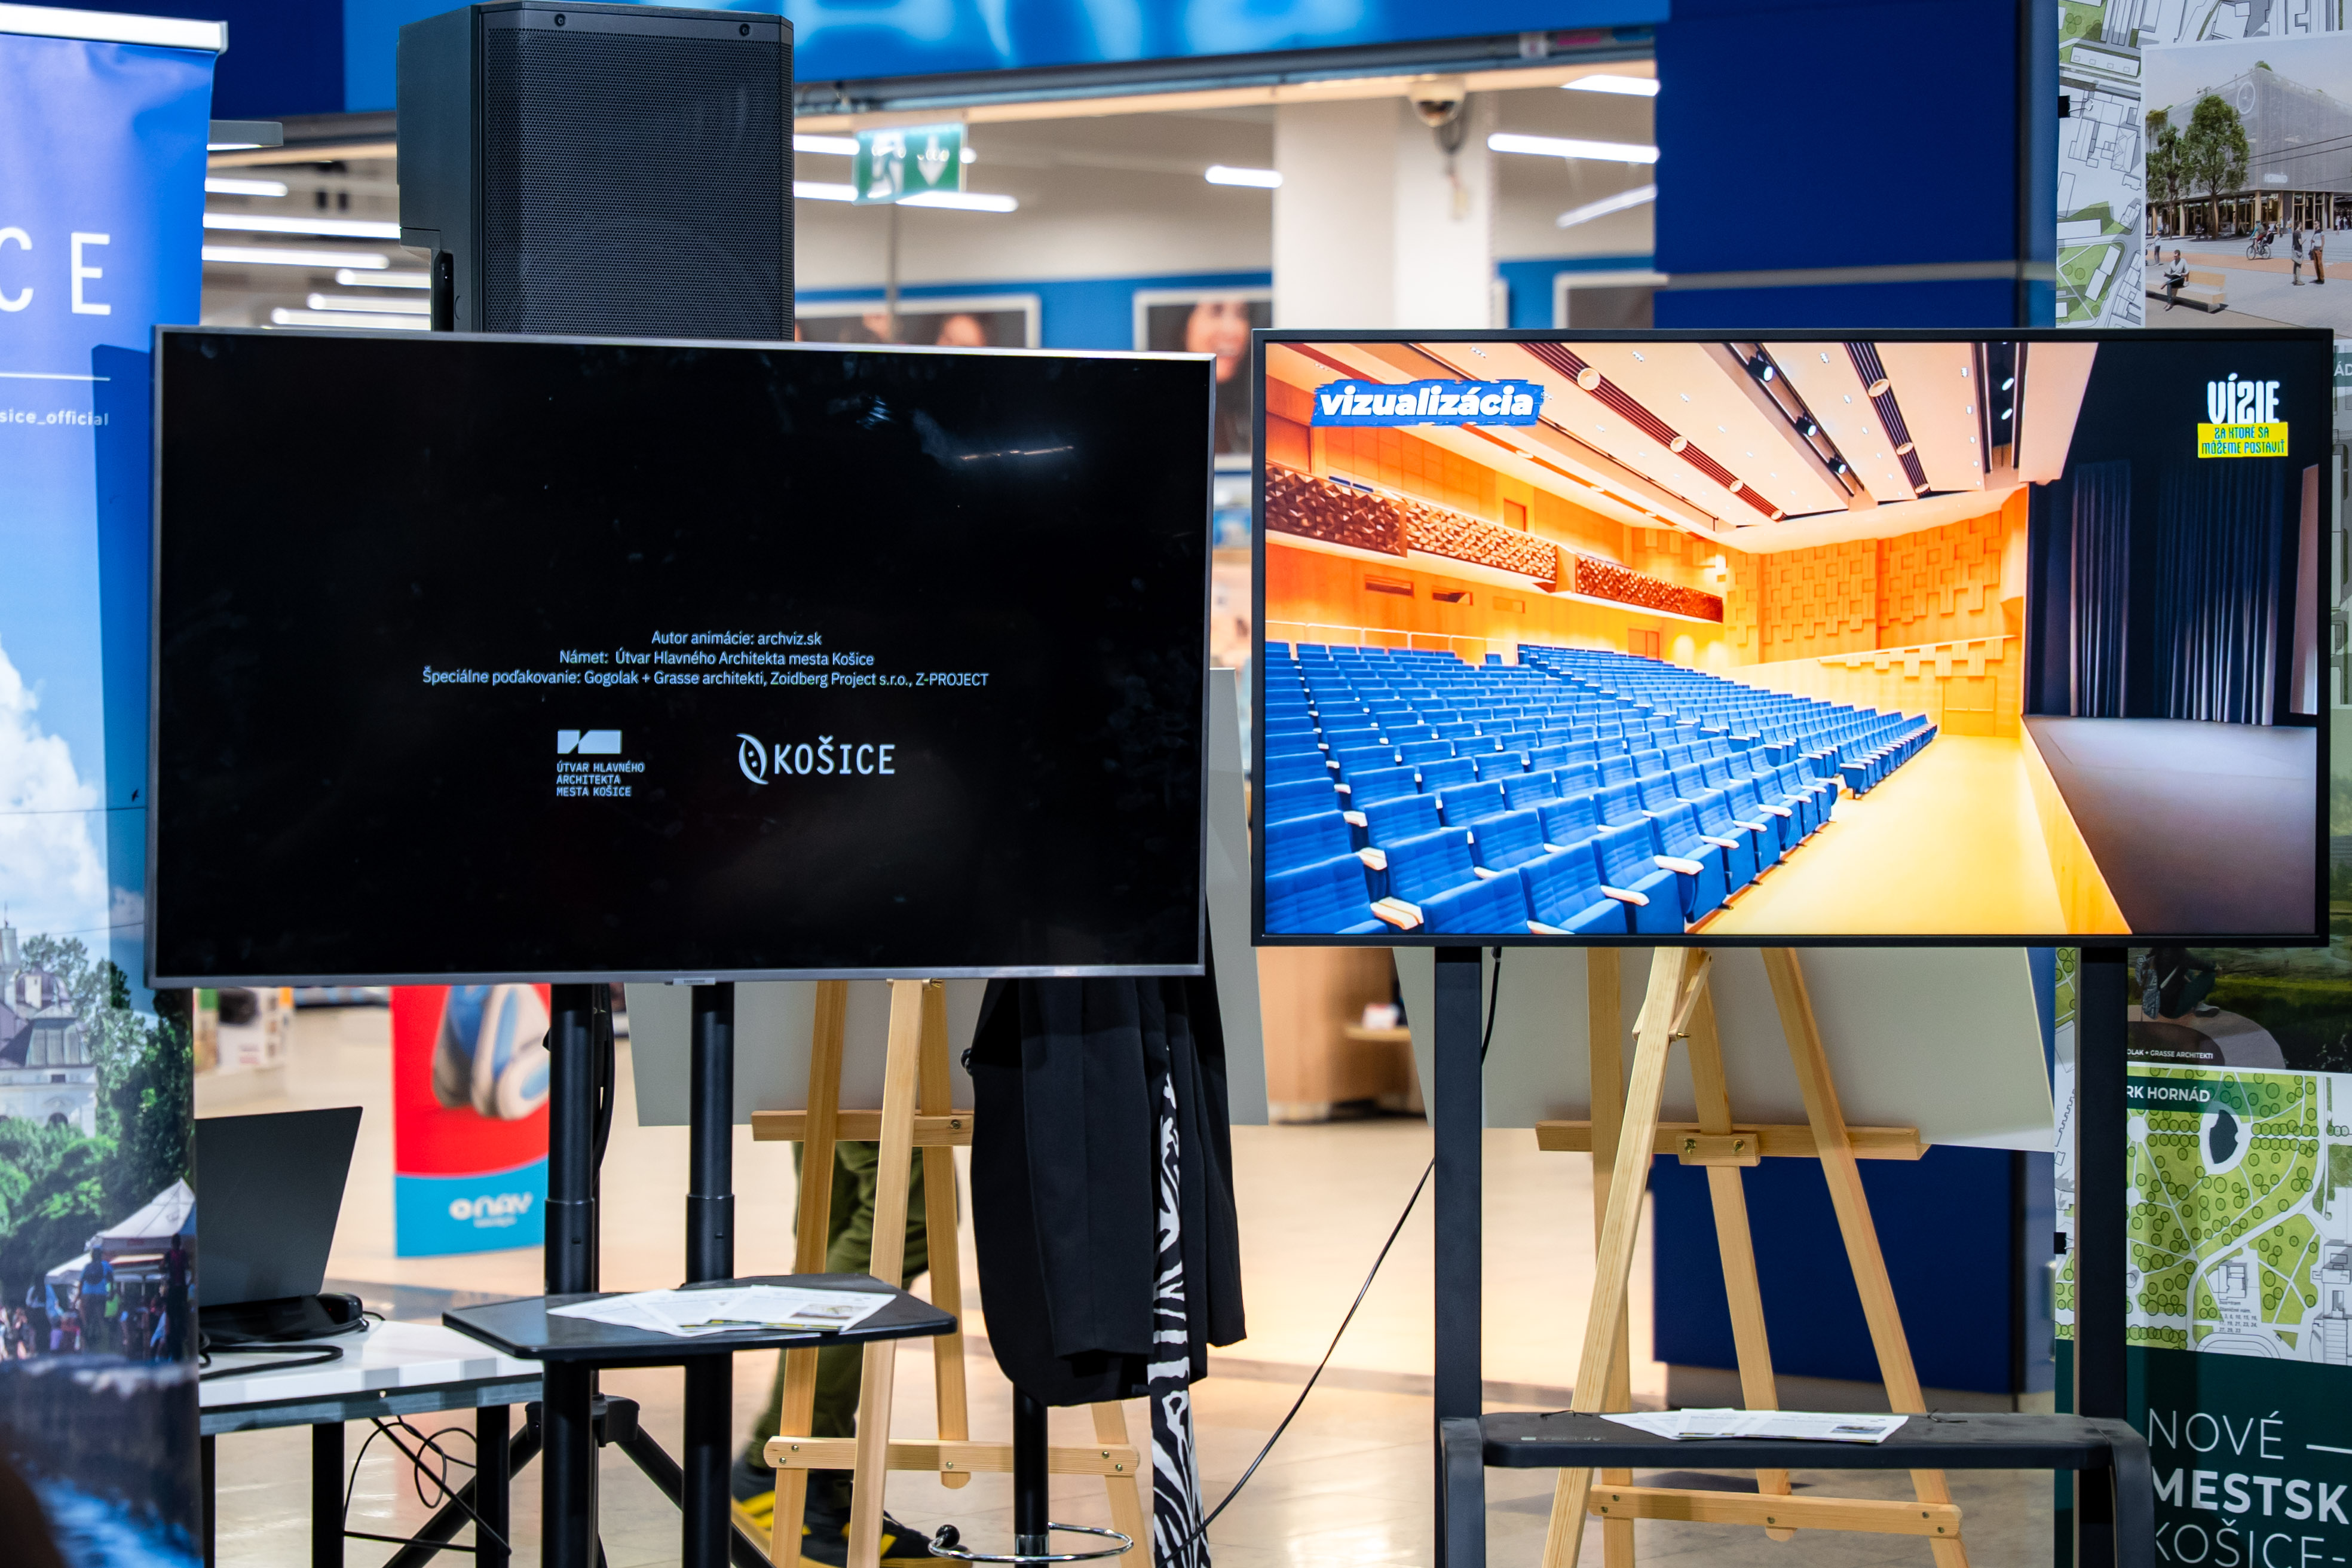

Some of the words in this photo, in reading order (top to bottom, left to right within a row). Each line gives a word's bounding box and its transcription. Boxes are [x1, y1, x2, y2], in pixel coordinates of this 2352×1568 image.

[1320, 385, 1534, 416] vizualizácia
[2215, 427, 2227, 439] ZA
[2229, 425, 2255, 439] KTORÉ
[2258, 426, 2270, 439] SA
[2201, 440, 2241, 455] MÔŽEME
[652, 631, 688, 645] Autor
[691, 631, 754, 645] animácie:
[758, 632, 822, 645] archviz.sk
[560, 649, 608, 664] Námet:
[615, 647, 651, 664] Útvar
[654, 650, 716, 664] Hlavného
[719, 651, 785, 665] Architekta
[789, 653, 829, 666] mesta
[832, 652, 874, 666] Košice
[422, 665, 489, 686] Špeciálne
[492, 669, 581, 687] poďakovanie:
[584, 670, 638, 687] Gogolak
[642, 673, 650, 683] +
[654, 670, 699, 685] Grasse
[702, 670, 767, 687] architekti,
[770, 671, 828, 688] Zoidberg
[831, 672, 876, 688] Project
[880, 675, 913, 688] s.r.o.,
[915, 672, 989, 686] Z-PROJECT
[774, 734, 896, 775] KOŠICE
[556, 759, 590, 773] ÚTVAR
[593, 760, 645, 773] HLAVNÉHO
[556, 774, 621, 785] ARCHITEKTA
[556, 786, 589, 797] MESTA
[593, 784, 632, 797] KOŠICE
[2148, 1086, 2210, 1102] HORNÁD
[2148, 1408, 2284, 1460] NOVÉ
[2151, 1466, 2350, 1524] MESTSK
